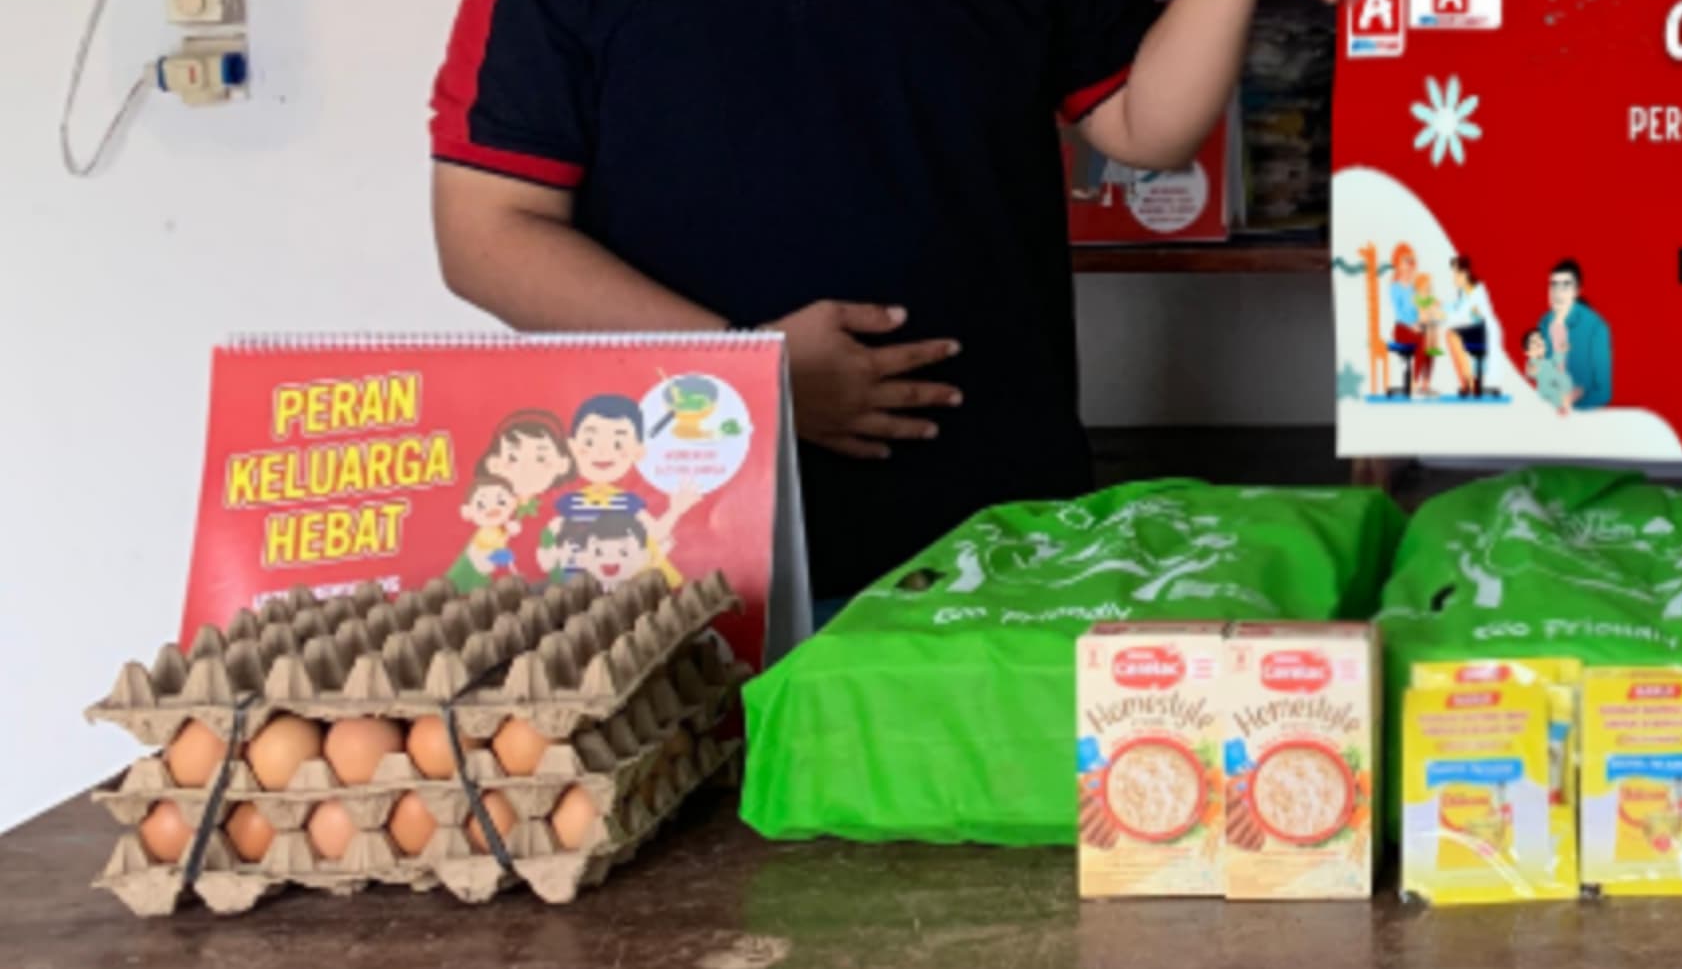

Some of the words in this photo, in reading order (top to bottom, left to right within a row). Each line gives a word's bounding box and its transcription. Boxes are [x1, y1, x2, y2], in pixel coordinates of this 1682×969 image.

[273, 372, 419, 438] PERAN
[226, 433, 453, 506] KELUARGA
[265, 501, 409, 566] HEBAT
[1087, 691, 1216, 734] Homestyle
[1233, 696, 1361, 737] Homestyle
